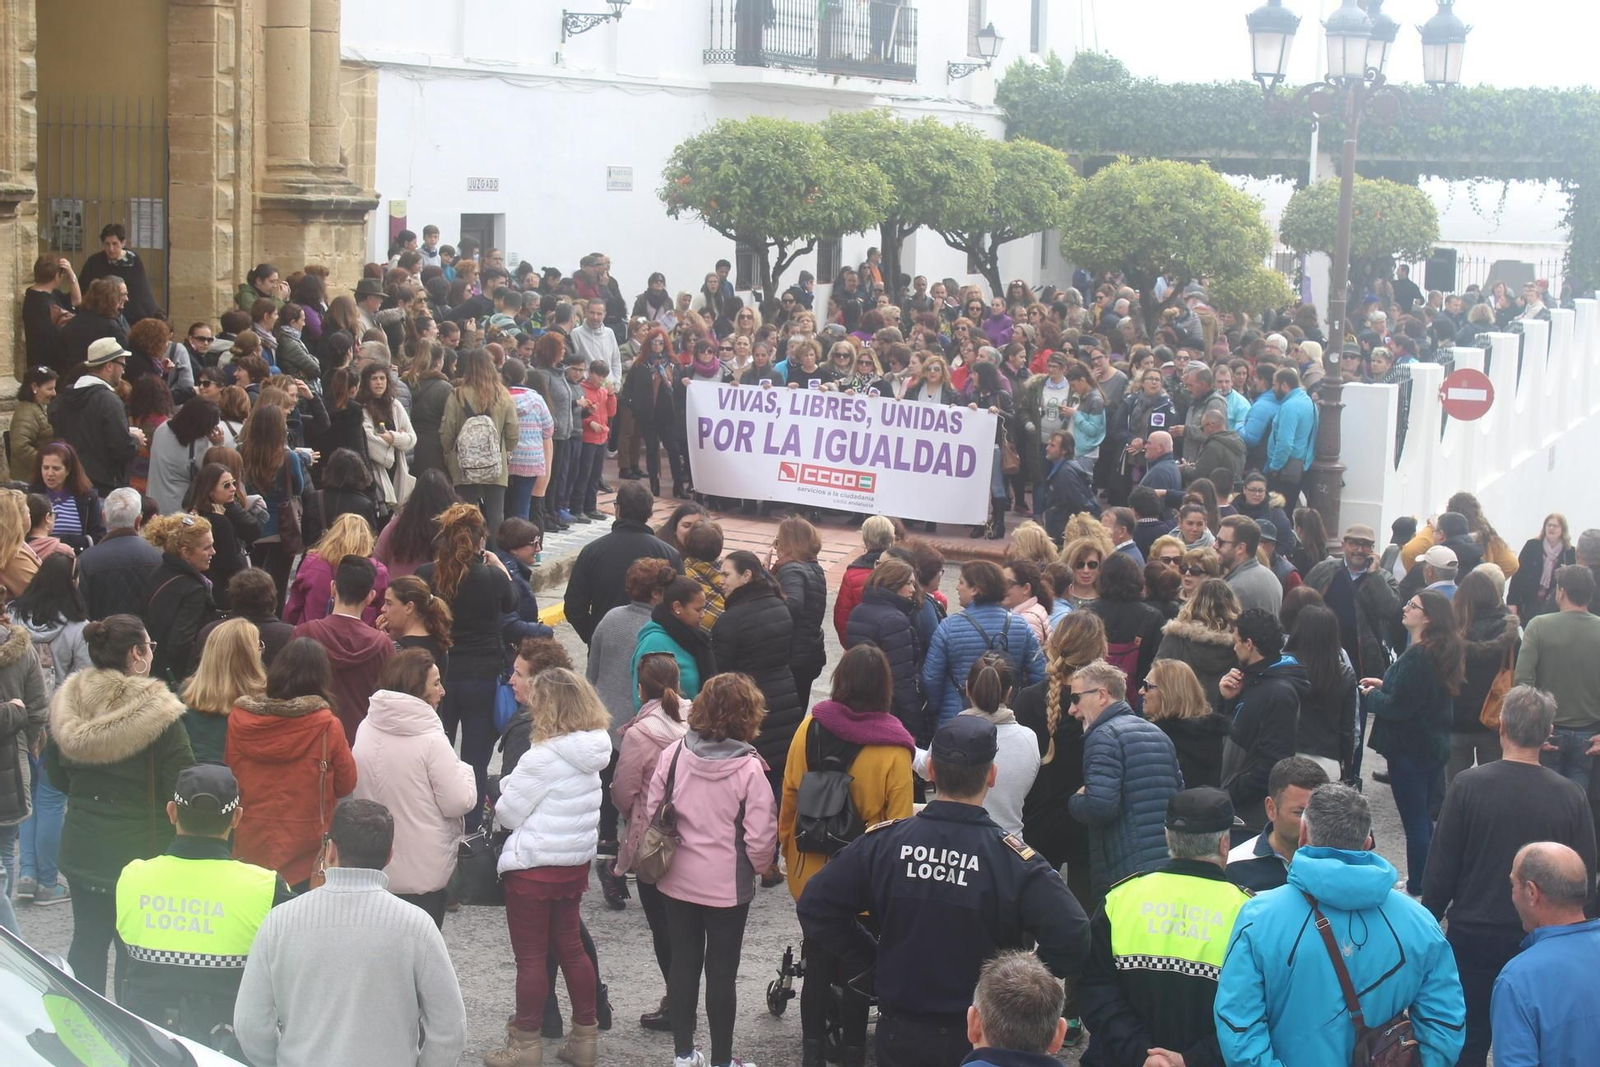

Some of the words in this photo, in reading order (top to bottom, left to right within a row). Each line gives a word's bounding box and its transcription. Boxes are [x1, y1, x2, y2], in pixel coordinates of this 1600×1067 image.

[469, 178, 498, 189] JUZGADO
[718, 388, 781, 418] VIVAS,
[789, 393, 872, 428] LIBRES,
[881, 403, 963, 434] UNIDAS
[698, 416, 755, 453] POR
[763, 422, 801, 457] LA
[813, 427, 976, 479] IGUALDAD
[803, 468, 857, 487] CCOO
[899, 845, 979, 871] POLICIA
[906, 862, 968, 887] LOCAL
[139, 895, 224, 917] POLICIA
[1141, 902, 1223, 926] POLICIA
[145, 913, 214, 934] LOCAL
[1148, 918, 1212, 941] LOCAL
